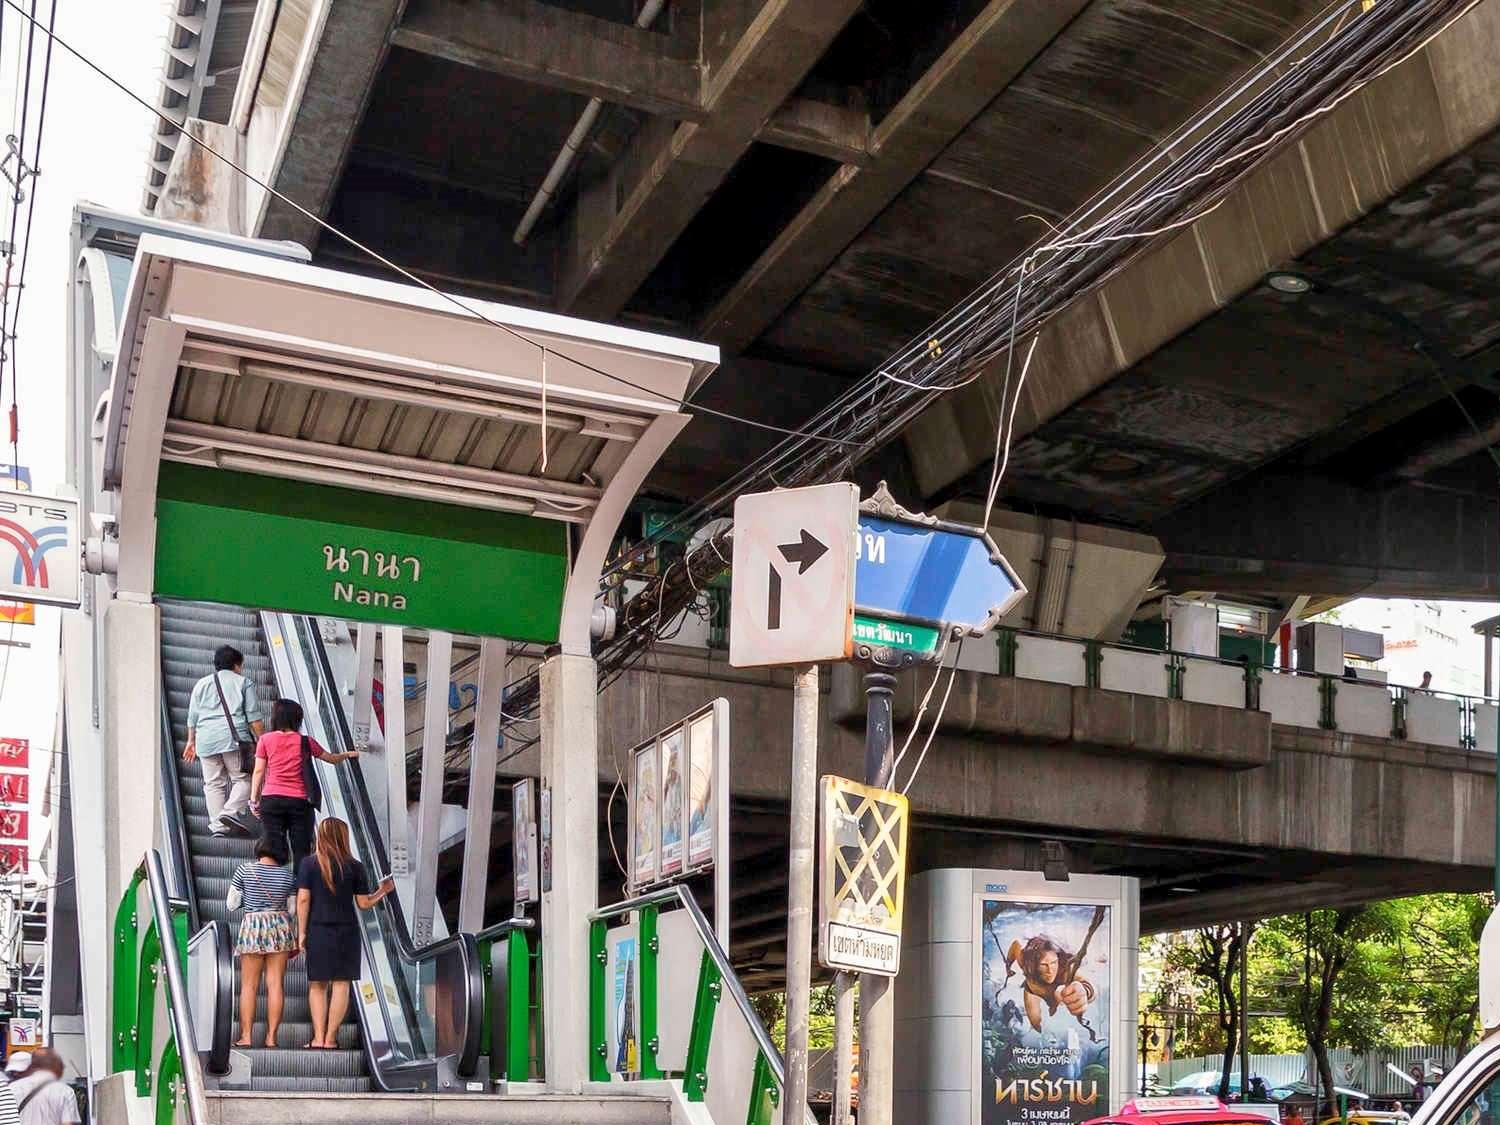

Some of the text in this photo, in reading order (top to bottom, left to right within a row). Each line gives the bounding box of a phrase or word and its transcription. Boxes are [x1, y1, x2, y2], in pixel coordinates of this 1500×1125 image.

[0, 501, 67, 520] BTS
[323, 545, 420, 582] นานา
[334, 582, 407, 610] Nana
[1020, 1108, 1028, 1119] 3
